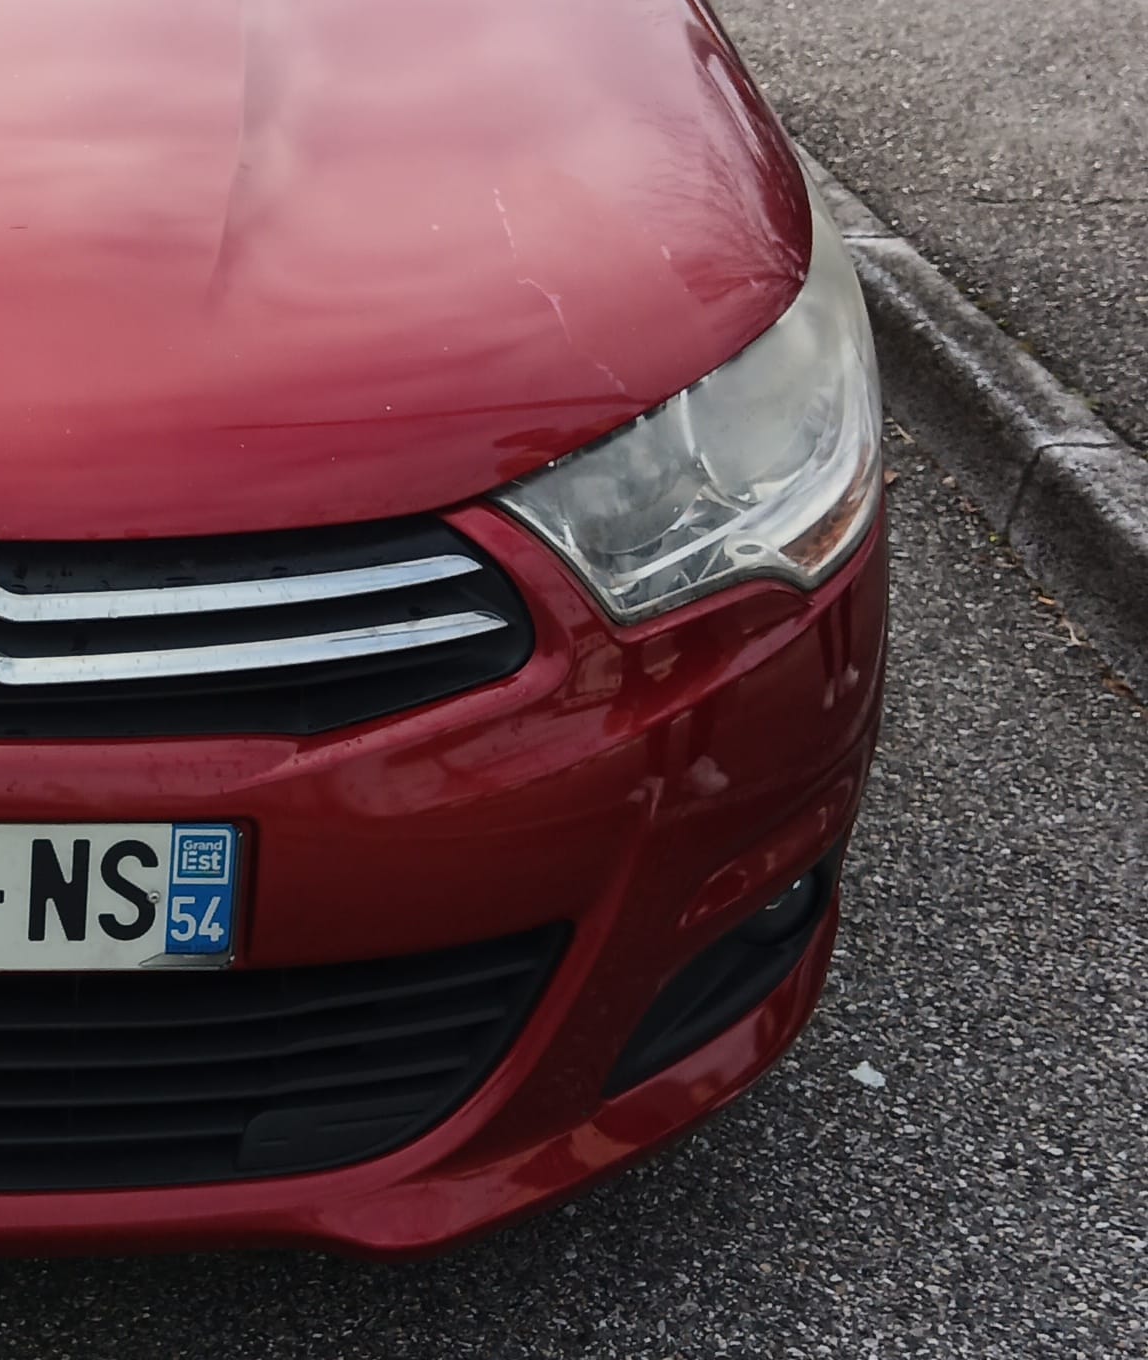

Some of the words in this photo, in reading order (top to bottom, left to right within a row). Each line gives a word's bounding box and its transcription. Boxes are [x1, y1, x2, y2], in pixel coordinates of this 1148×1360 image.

[183, 840, 223, 851] Grand
[182, 851, 221, 870] Est
[170, 896, 224, 942] 54
